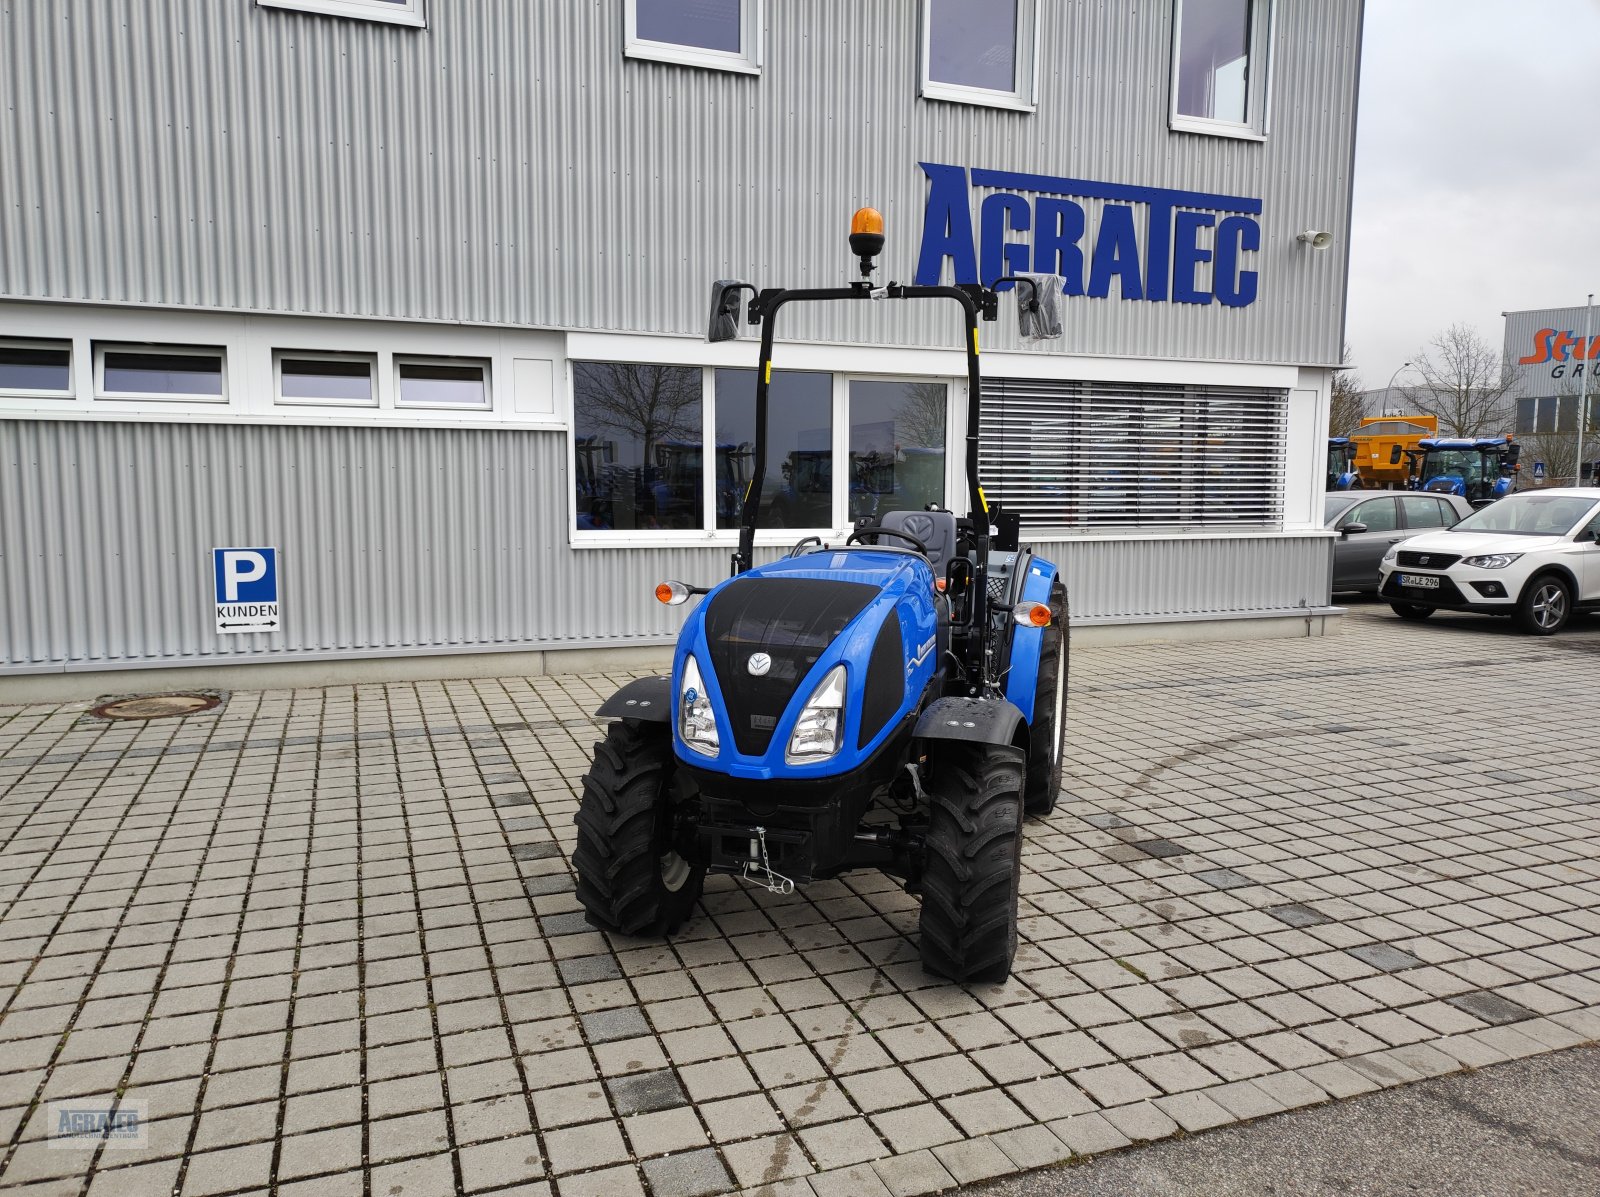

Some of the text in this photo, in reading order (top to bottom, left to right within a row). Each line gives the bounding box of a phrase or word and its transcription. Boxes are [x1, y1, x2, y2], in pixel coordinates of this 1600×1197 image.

[915, 161, 1263, 308] AGRATEC
[223, 551, 267, 601] P
[1425, 577, 1439, 587] 296
[217, 604, 278, 618] KUNDEN
